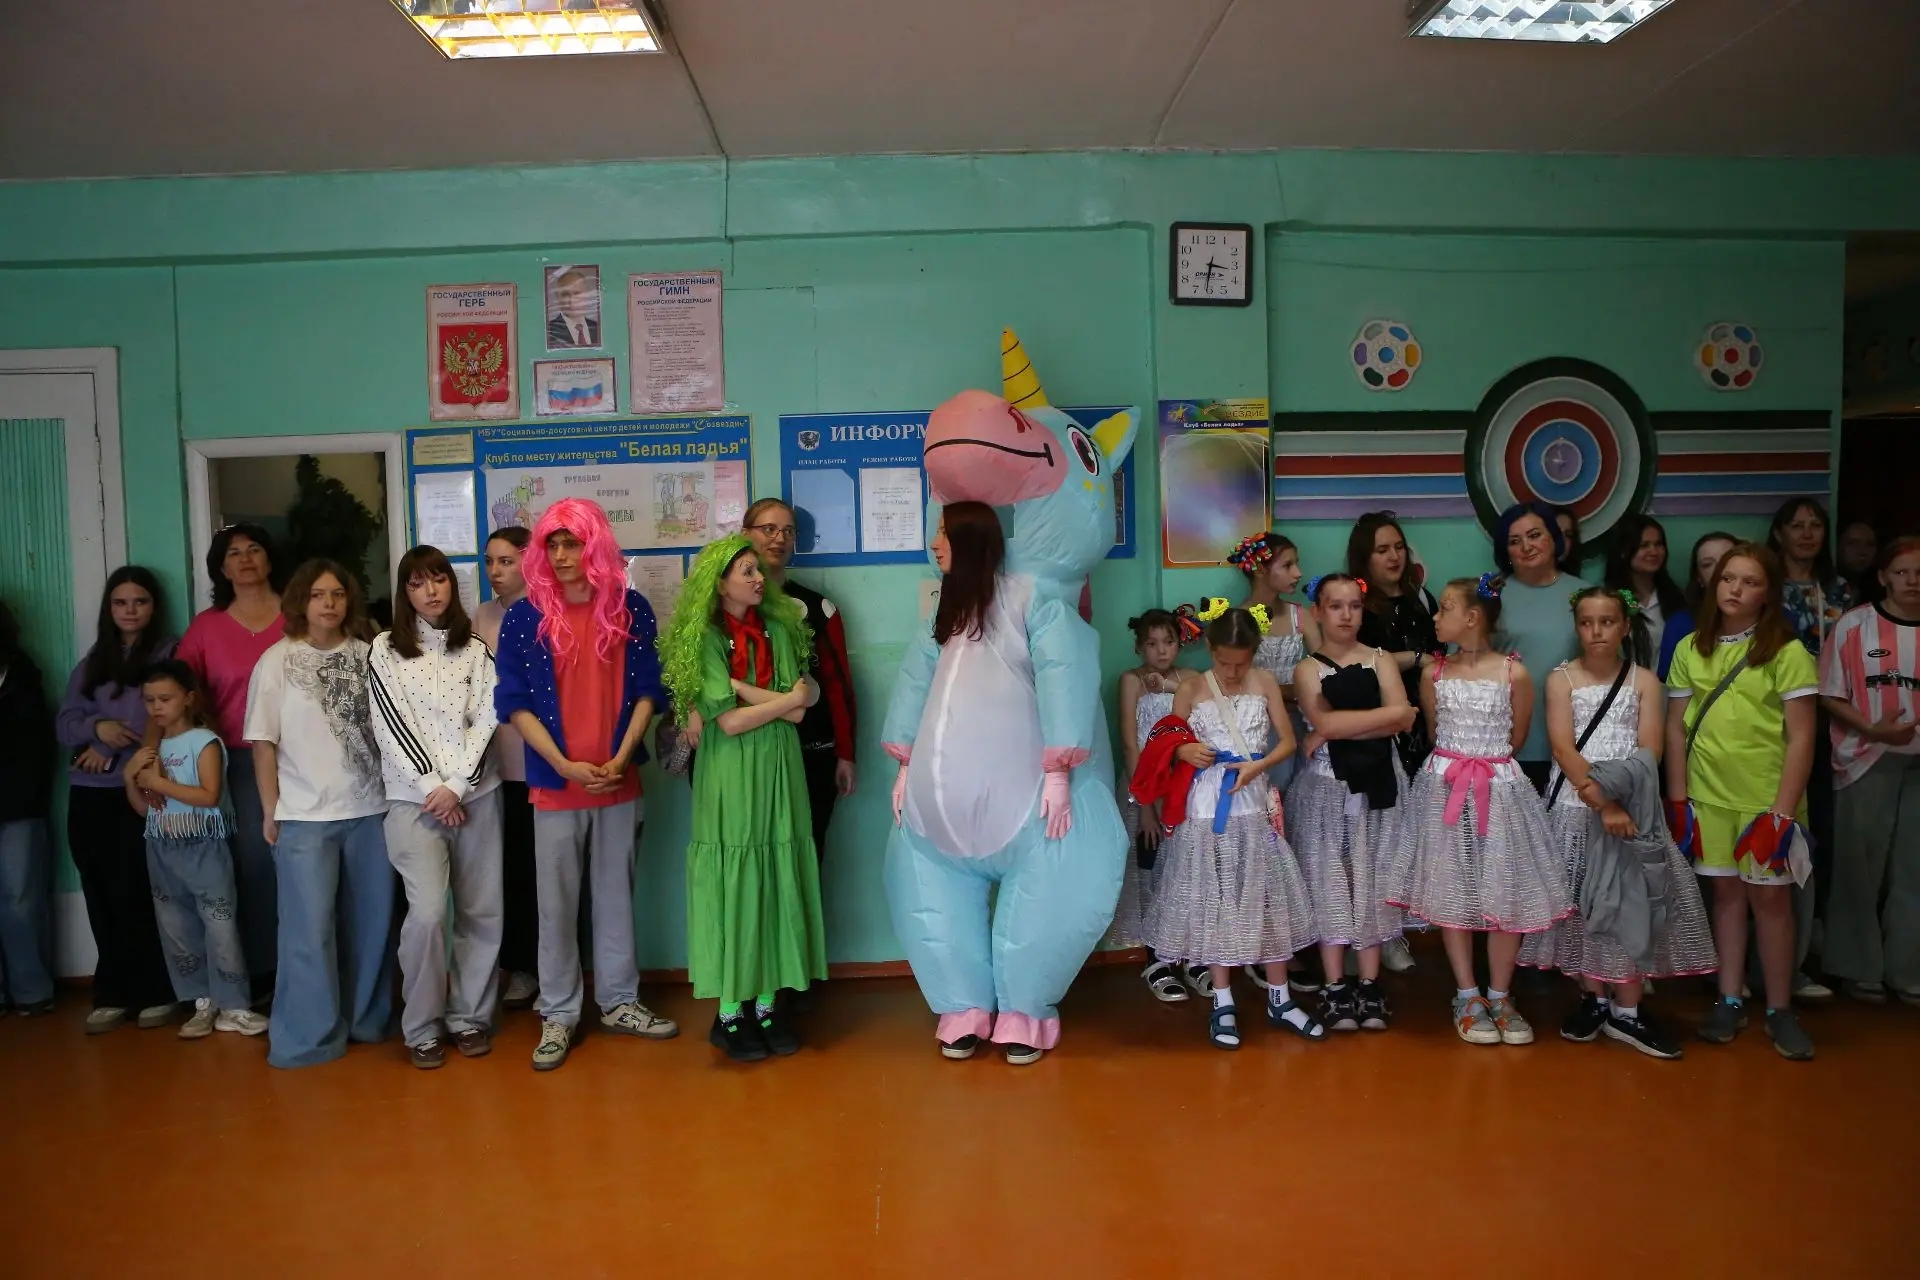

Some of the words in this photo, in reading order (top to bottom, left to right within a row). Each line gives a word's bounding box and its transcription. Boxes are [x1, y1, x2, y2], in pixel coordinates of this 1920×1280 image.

[1192, 235, 1200, 244] 11
[1205, 234, 1216, 245] 12
[1181, 245, 1192, 255] 10
[1231, 246, 1238, 256] 2
[1181, 260, 1189, 269] 9
[1231, 260, 1239, 271] 3
[633, 277, 715, 287] ГОСУДАРСТВЕННЫЙ
[1181, 275, 1189, 284] 8
[1231, 276, 1238, 285] 4
[432, 289, 511, 299] ГОСУДАРСТВЕННЫЙ
[659, 286, 690, 296] ГИМН
[1192, 285, 1200, 294] 7
[1205, 285, 1214, 295] 6
[1220, 285, 1228, 295] 5
[459, 298, 486, 308] ГЕРБ
[618, 422, 641, 432] детей
[830, 424, 927, 442] ИНФОРМ
[485, 452, 510, 465] Клуб
[511, 453, 523, 462] по
[526, 451, 555, 463] месту
[557, 449, 618, 461] жительства
[620, 440, 682, 457] "Белая
[686, 437, 748, 457] ладья"
[889, 455, 918, 463] РАБОТЫ
